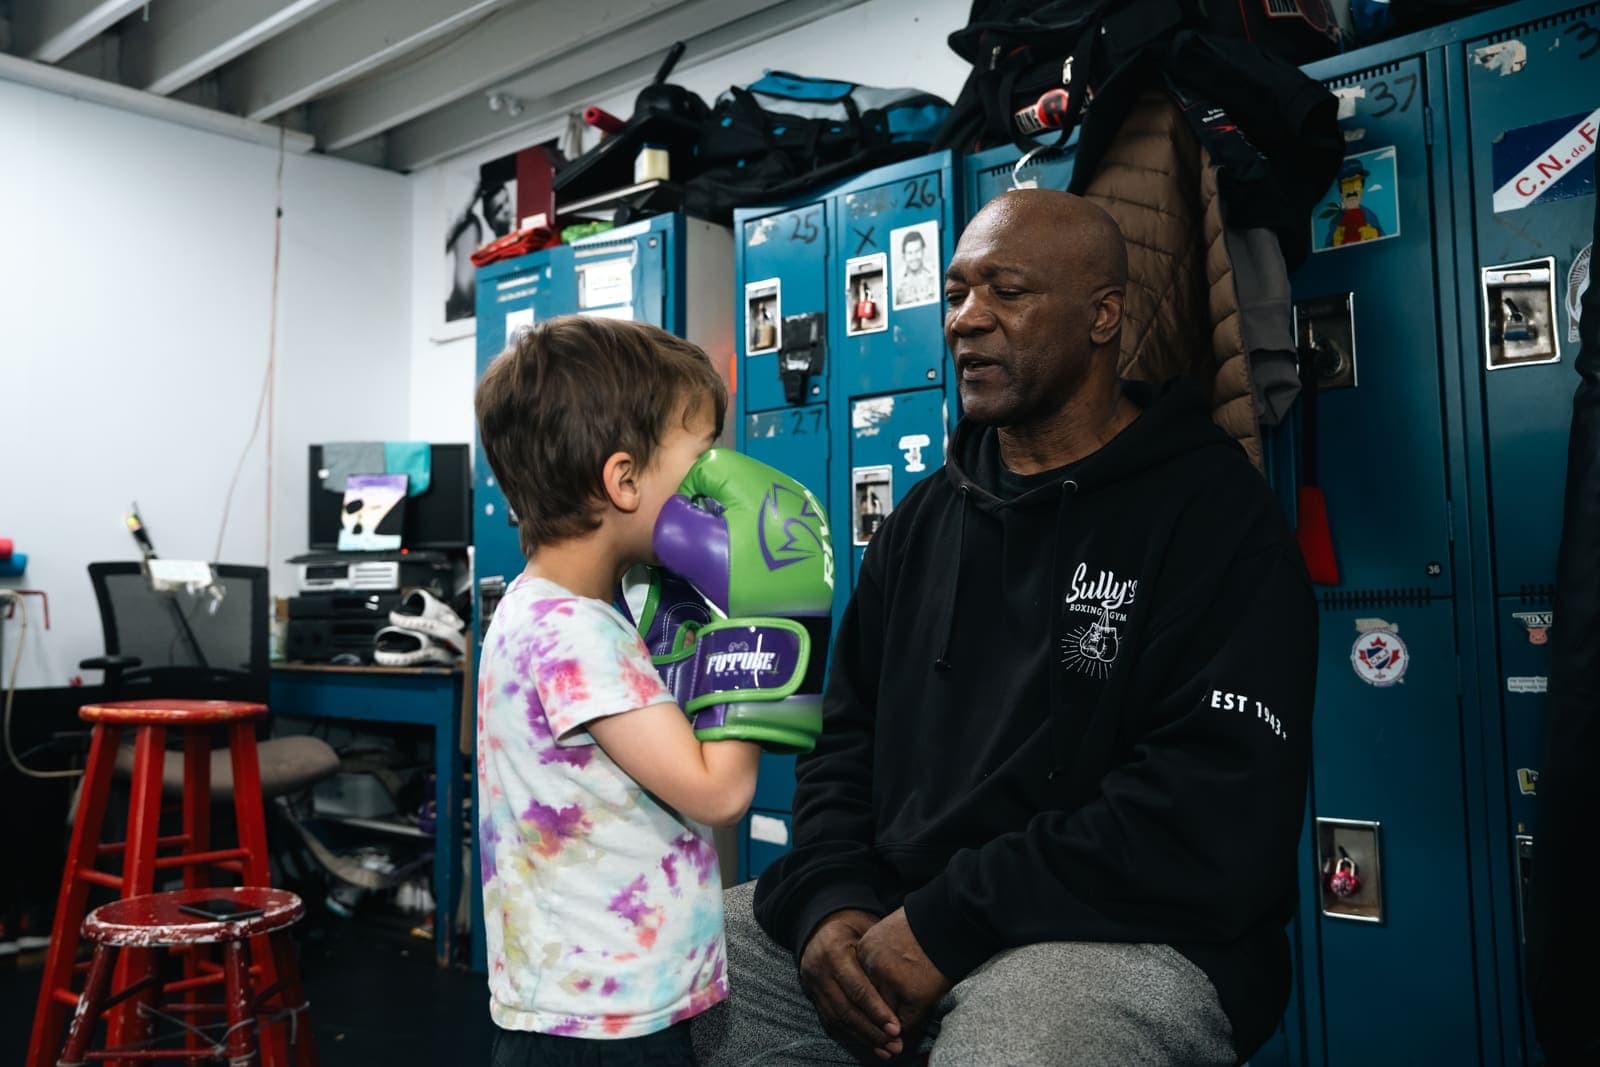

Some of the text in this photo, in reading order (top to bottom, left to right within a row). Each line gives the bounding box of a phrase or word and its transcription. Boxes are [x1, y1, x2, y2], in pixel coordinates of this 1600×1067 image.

[1369, 73, 1417, 117] 37
[905, 179, 936, 209] 26
[790, 213, 819, 243] 25
[791, 409, 822, 435] 27
[1066, 562, 1138, 609] Sully's
[1069, 603, 1127, 622] BOXING GYM
[706, 652, 776, 675] FUTURE
[1211, 690, 1248, 712] EST
